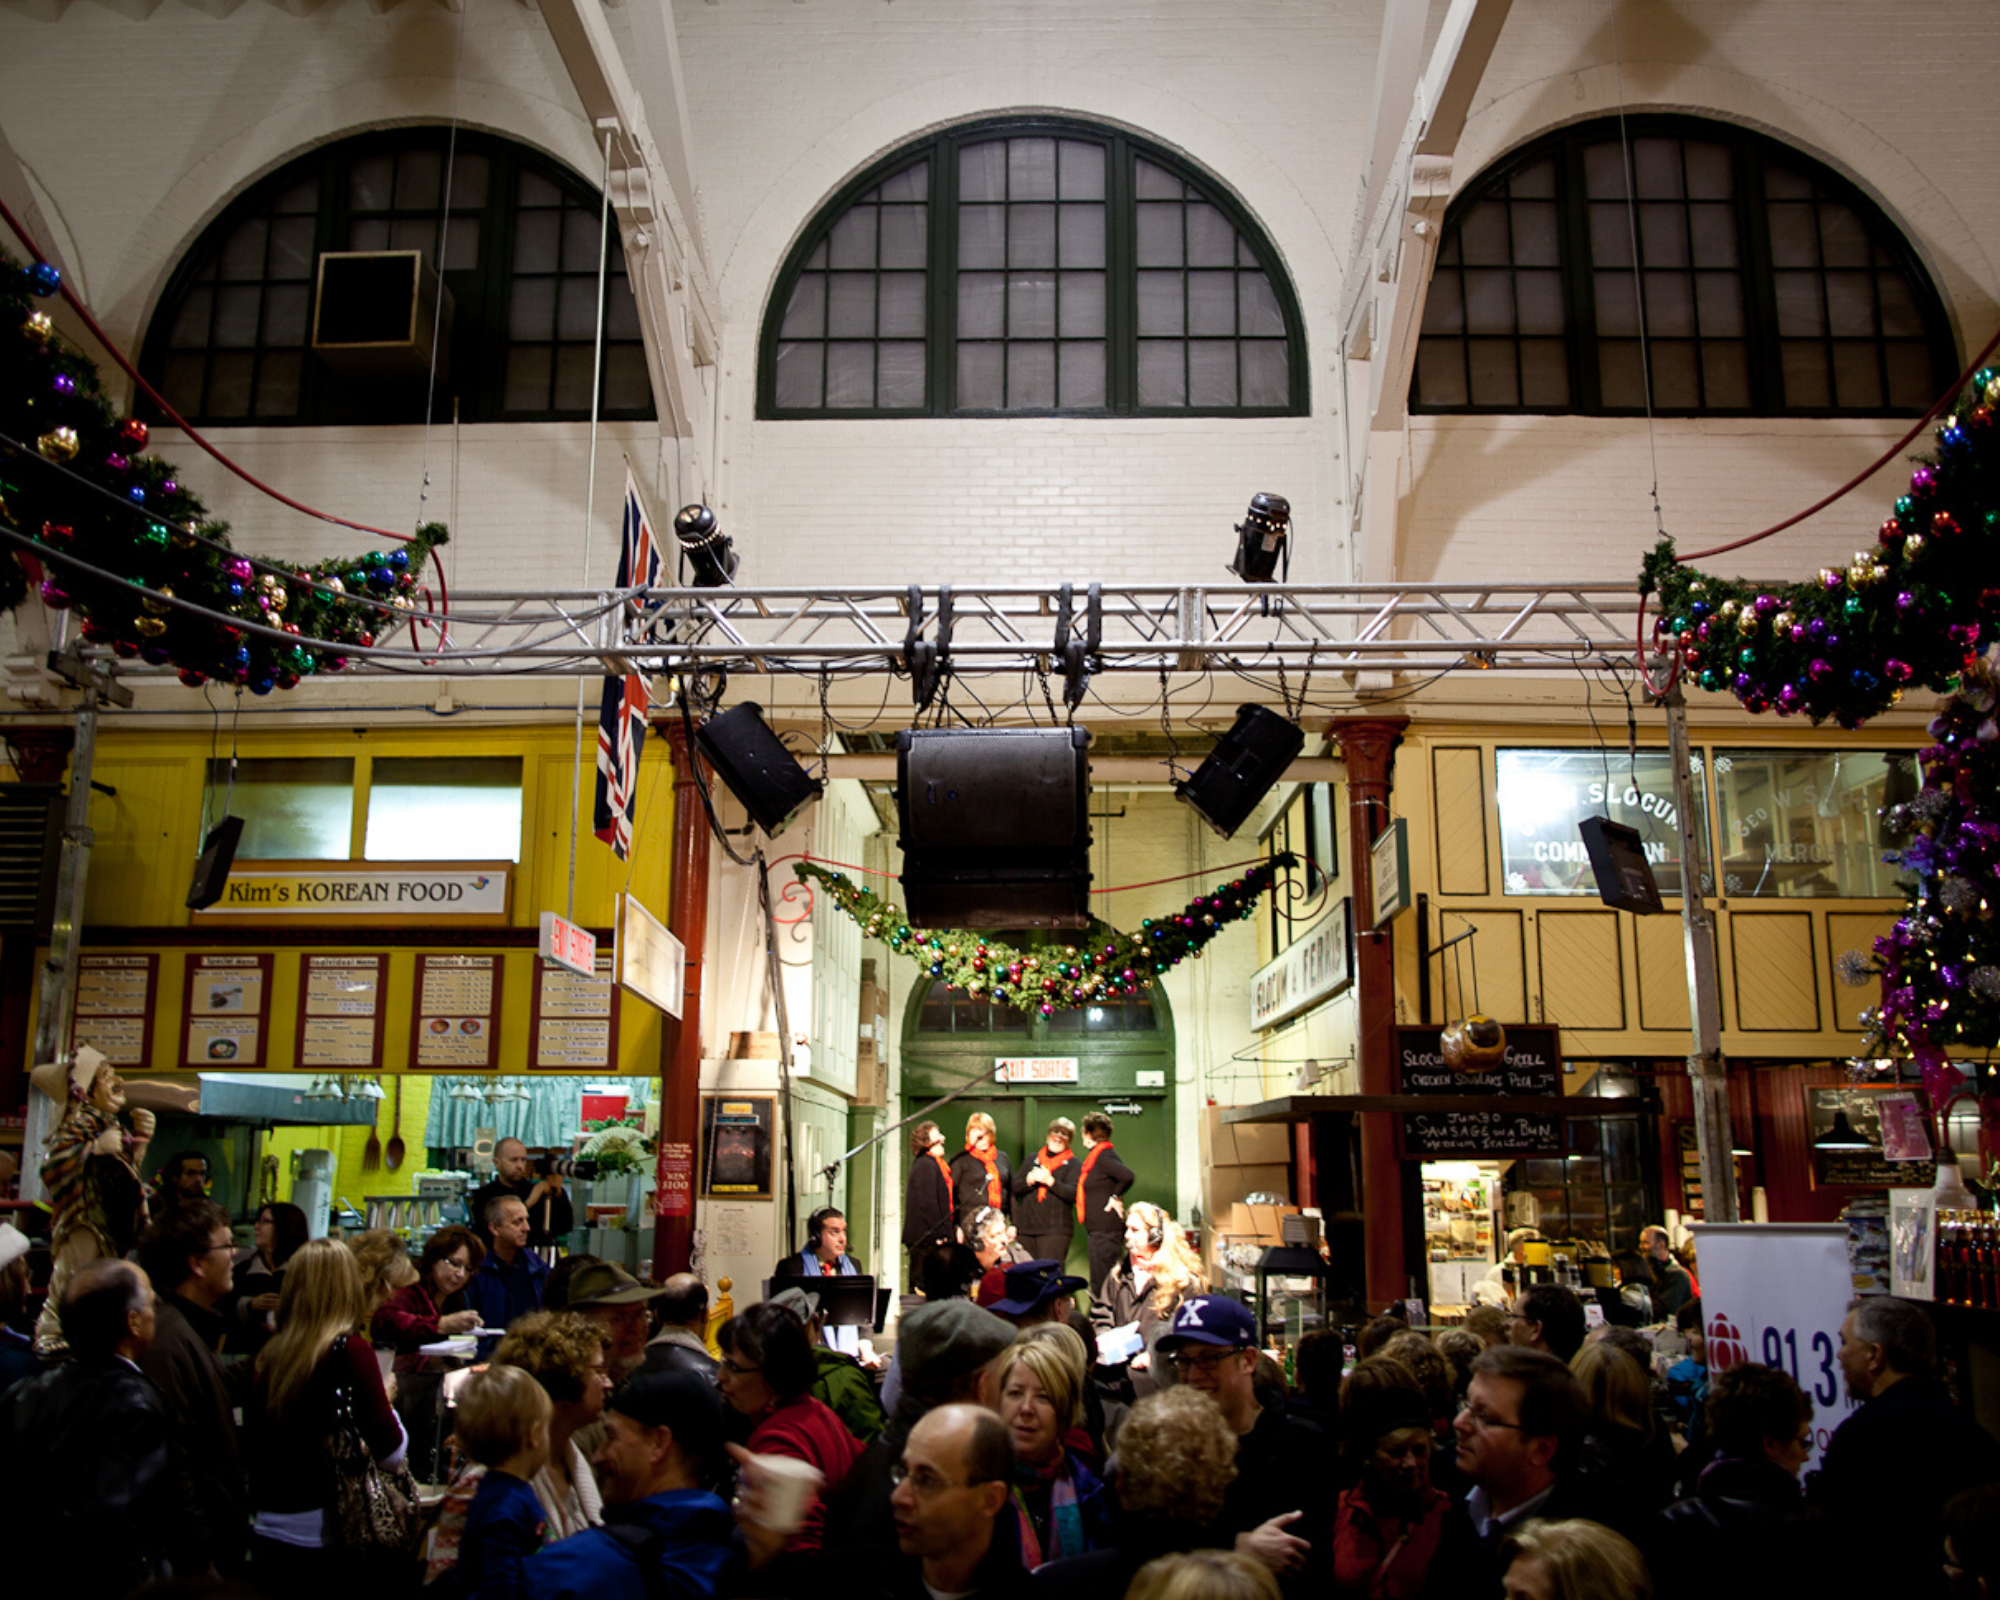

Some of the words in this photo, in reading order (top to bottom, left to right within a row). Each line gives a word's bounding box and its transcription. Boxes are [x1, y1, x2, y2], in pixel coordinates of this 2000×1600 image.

[228, 881, 289, 901] Kim's
[296, 882, 390, 901] KOREAN
[397, 882, 463, 901] FOOD
[1302, 920, 1342, 994] FERRIS
[1504, 1045, 1546, 1067] GRILL
[1031, 1060, 1071, 1078] SORTIE
[662, 1180, 689, 1190] $100
[1178, 1298, 1209, 1327] X
[1763, 1325, 1837, 1408] 91.3
